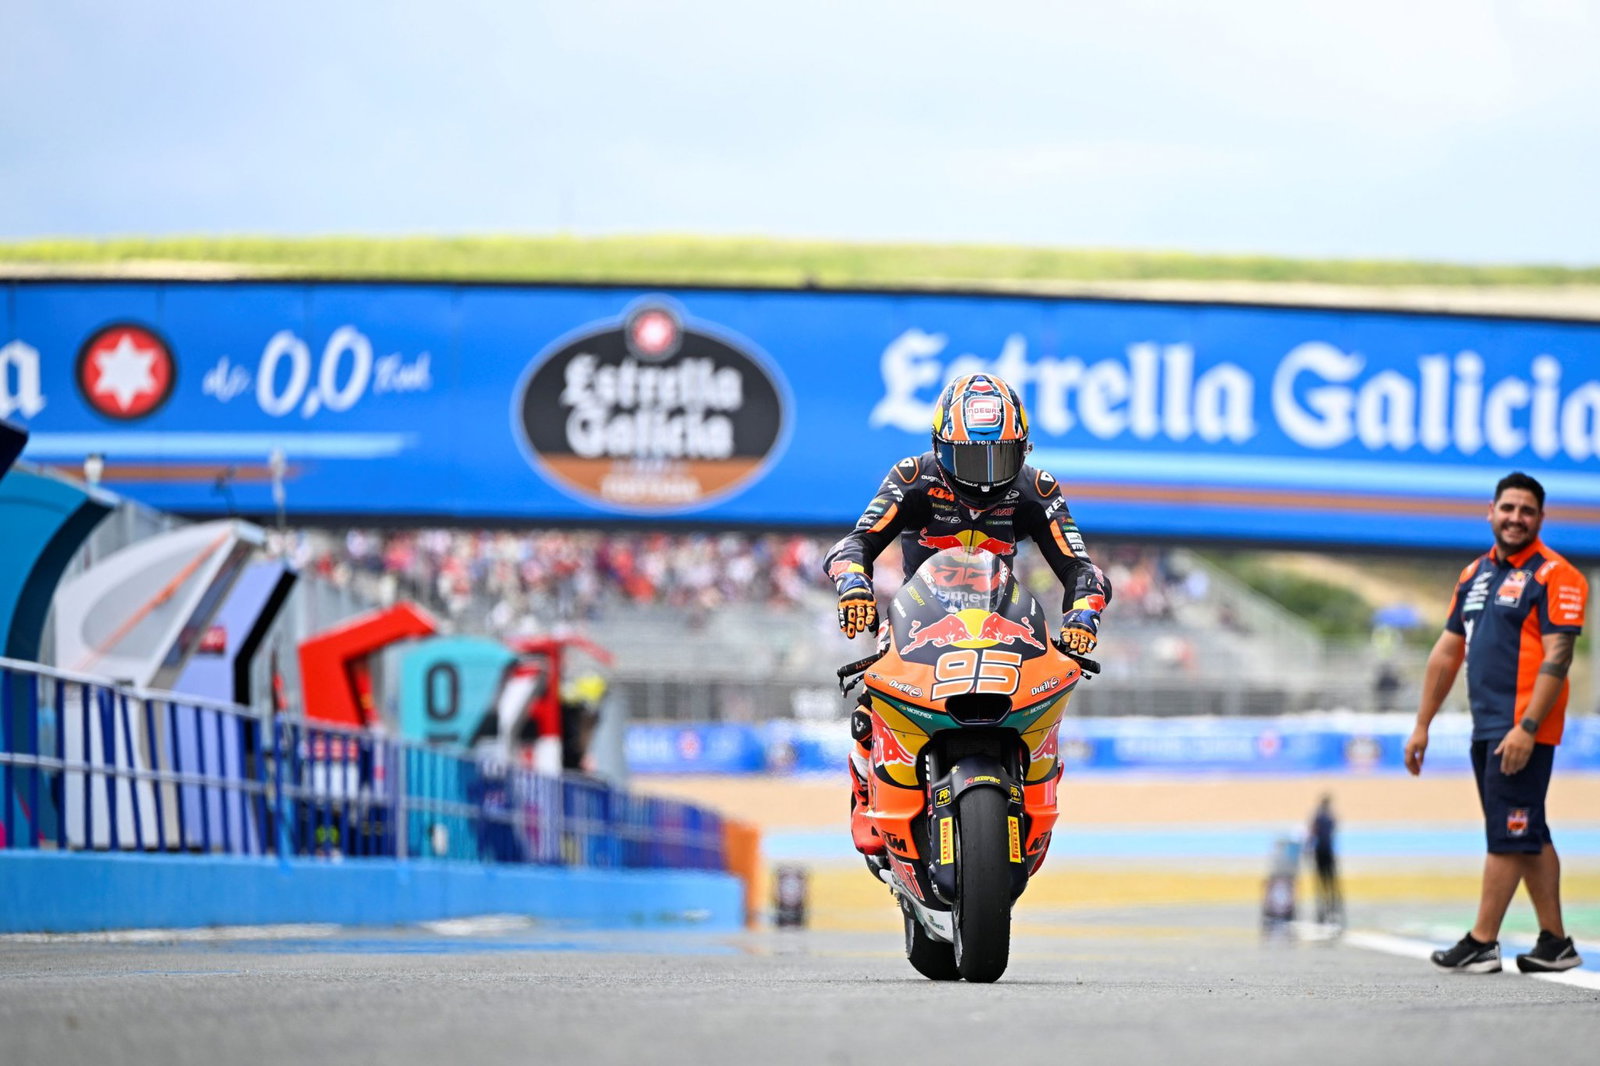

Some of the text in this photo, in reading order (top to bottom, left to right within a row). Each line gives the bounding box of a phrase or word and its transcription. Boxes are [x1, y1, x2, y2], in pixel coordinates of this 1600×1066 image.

[1271, 341, 1600, 462] Galicia
[927, 487, 955, 502] KTM
[931, 648, 1022, 701] 95
